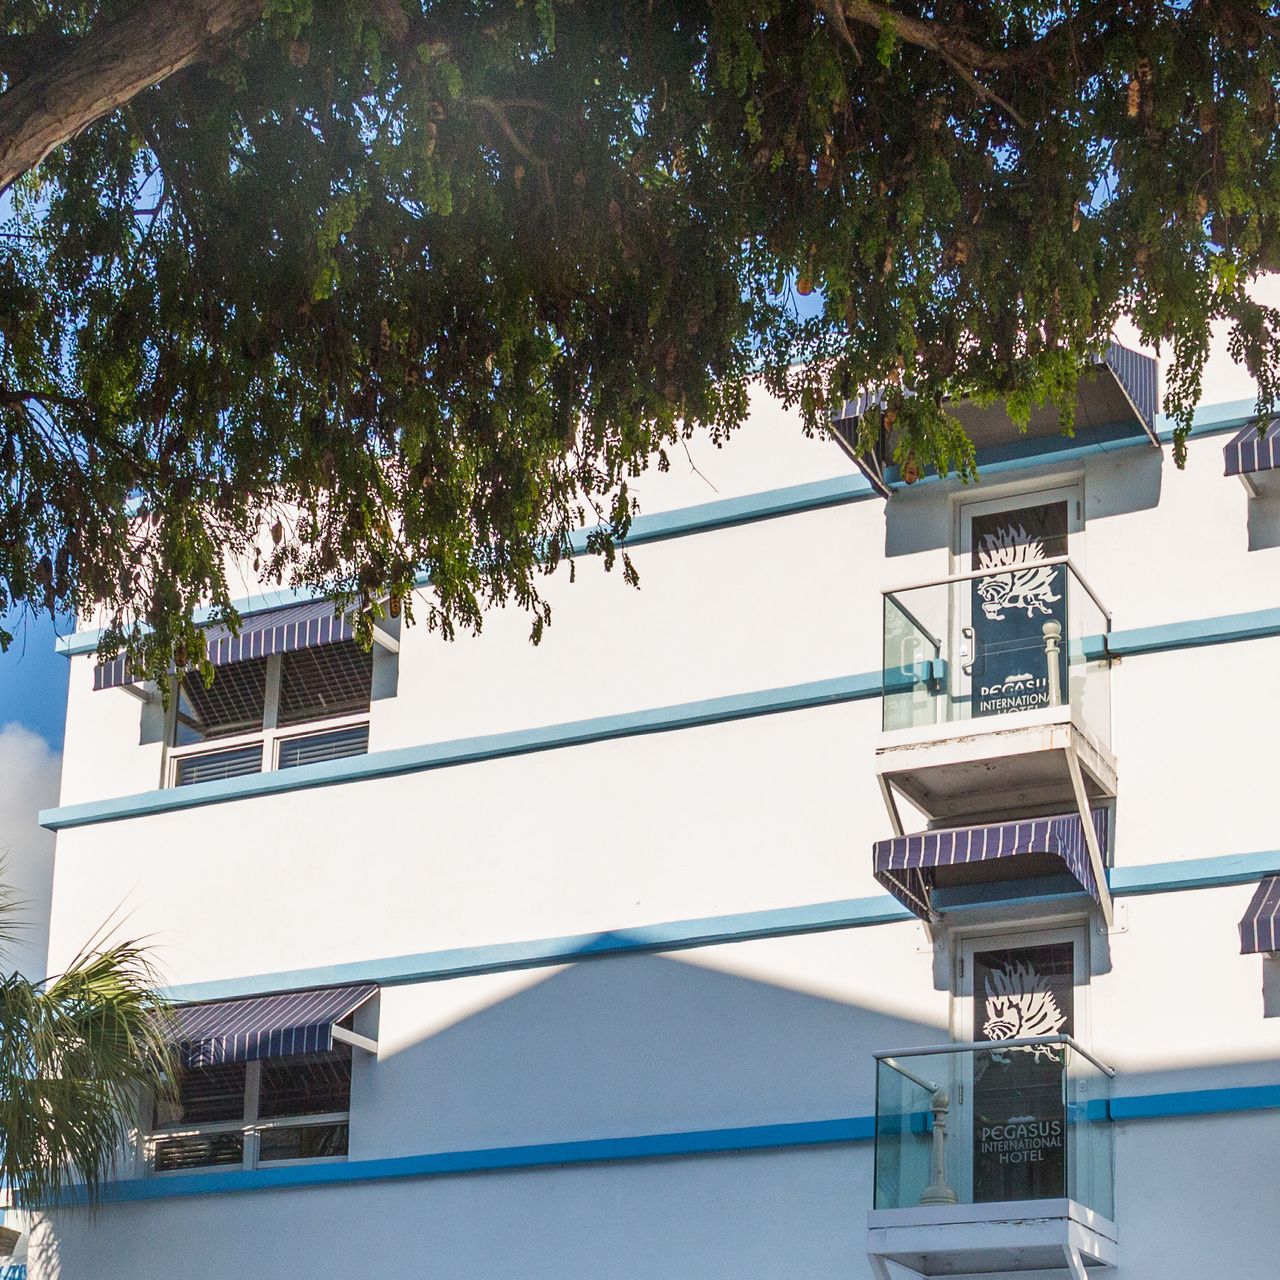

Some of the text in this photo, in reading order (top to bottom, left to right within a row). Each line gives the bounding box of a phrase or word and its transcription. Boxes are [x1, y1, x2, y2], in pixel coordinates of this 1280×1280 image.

[981, 677, 1048, 700] PEGASU
[981, 691, 1050, 711] INTERNATION
[982, 1121, 1061, 1141] PEGASUS
[981, 1136, 1062, 1153] INTERNATIONAL
[1000, 1150, 1044, 1164] HOTEL
